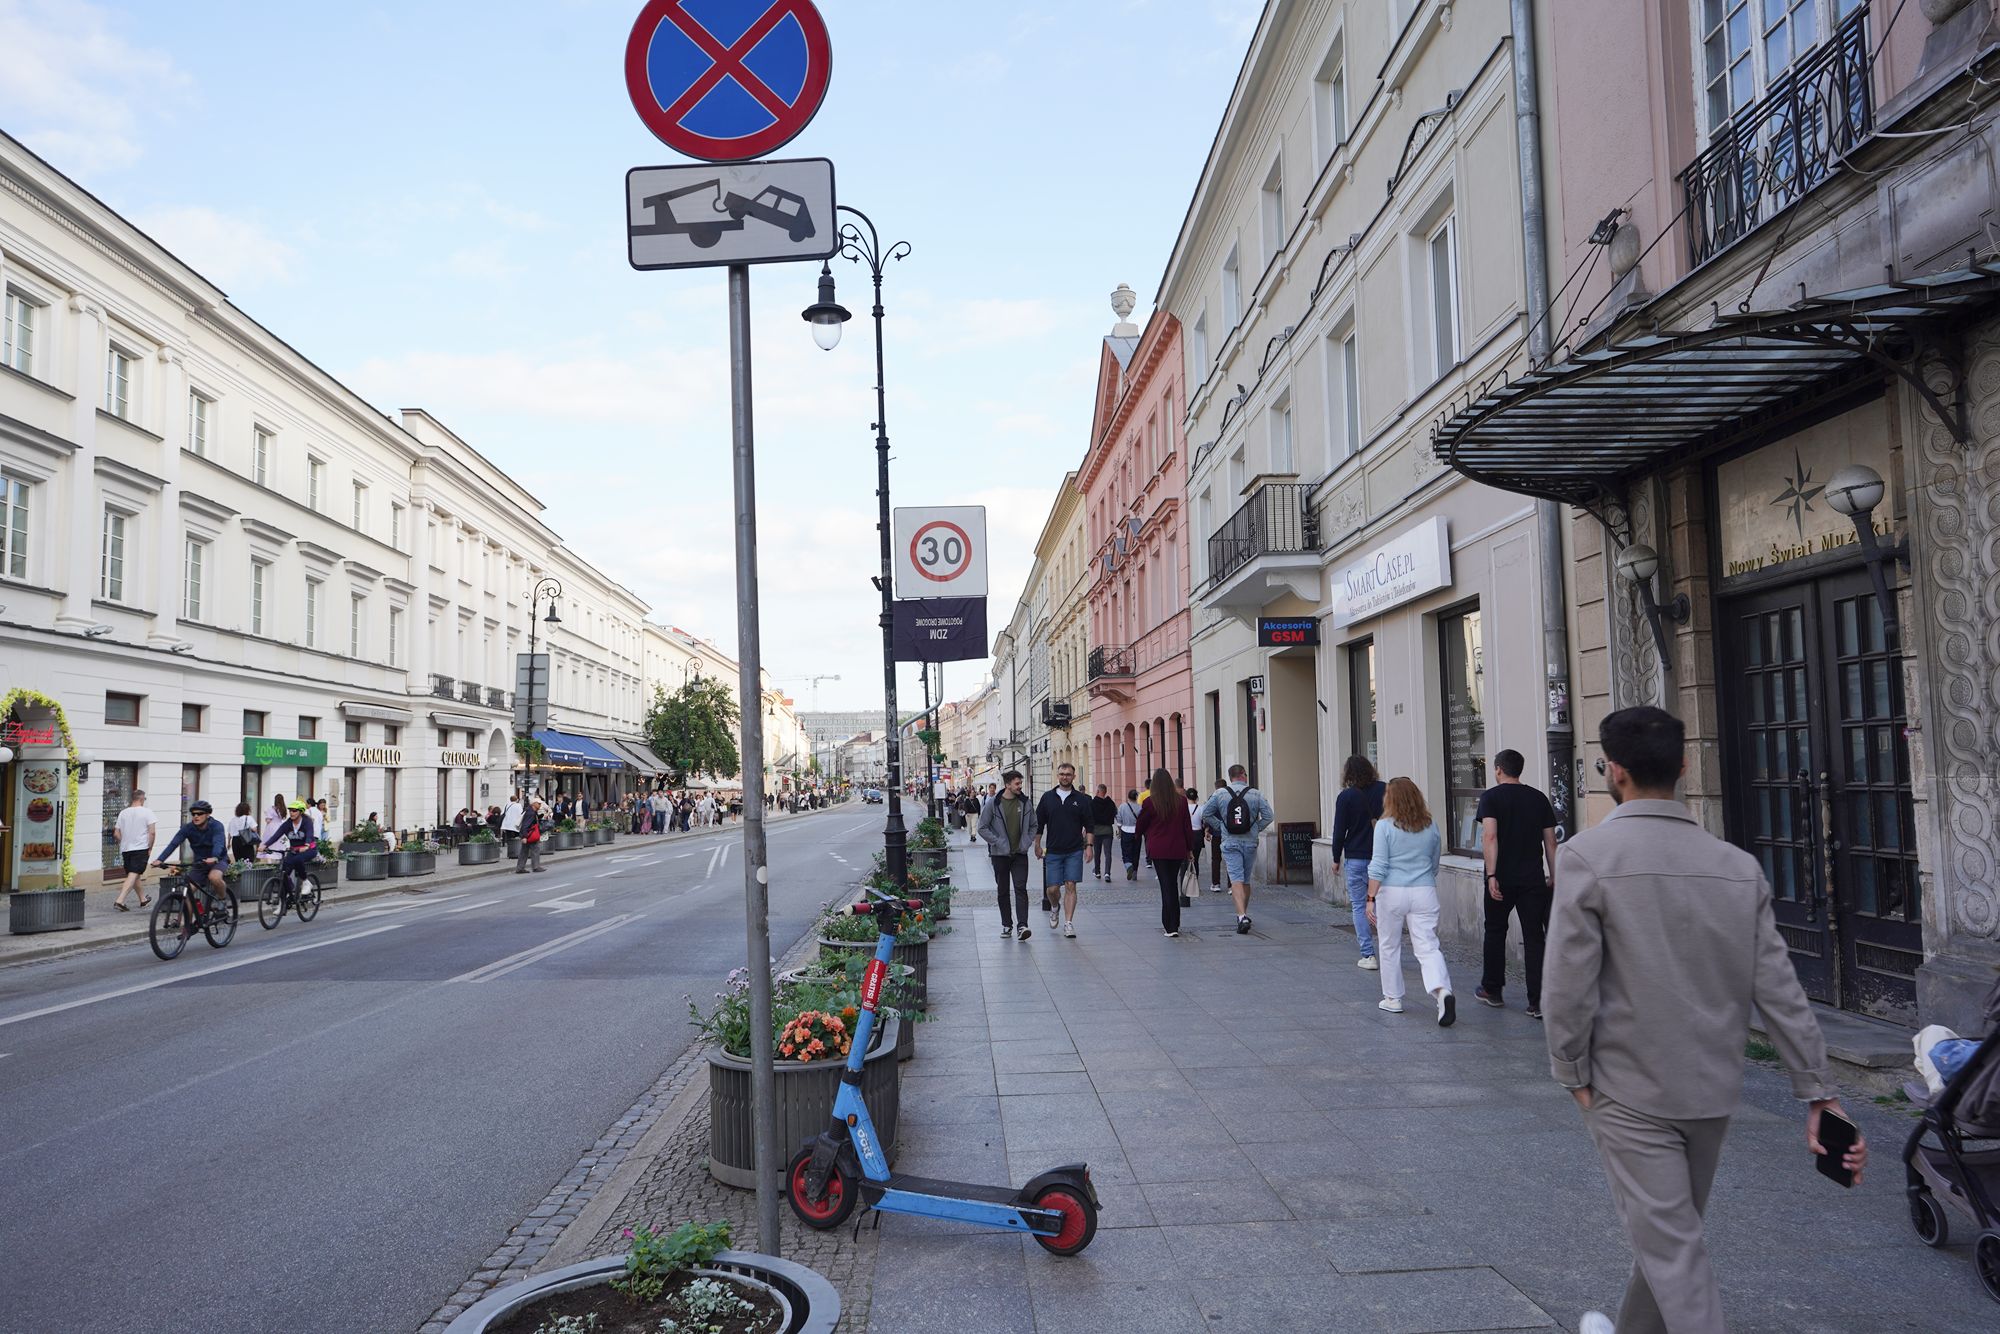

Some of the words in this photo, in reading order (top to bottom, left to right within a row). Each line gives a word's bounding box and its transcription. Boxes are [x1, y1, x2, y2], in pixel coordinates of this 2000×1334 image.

[920, 537, 962, 565] 30
[1729, 556, 1764, 575] Nowy
[1771, 540, 1813, 564] Świat
[1821, 517, 1892, 550] Muzki
[929, 628, 948, 640] ZDM
[1263, 621, 1313, 631] Akcesoria
[1271, 630, 1305, 643] GSM
[1251, 679, 1263, 690] 61
[255, 742, 284, 759] żabka
[354, 748, 402, 766] KARMELLO
[442, 751, 481, 767] CZEKOLADA
[1234, 806, 1242, 825] FILA
